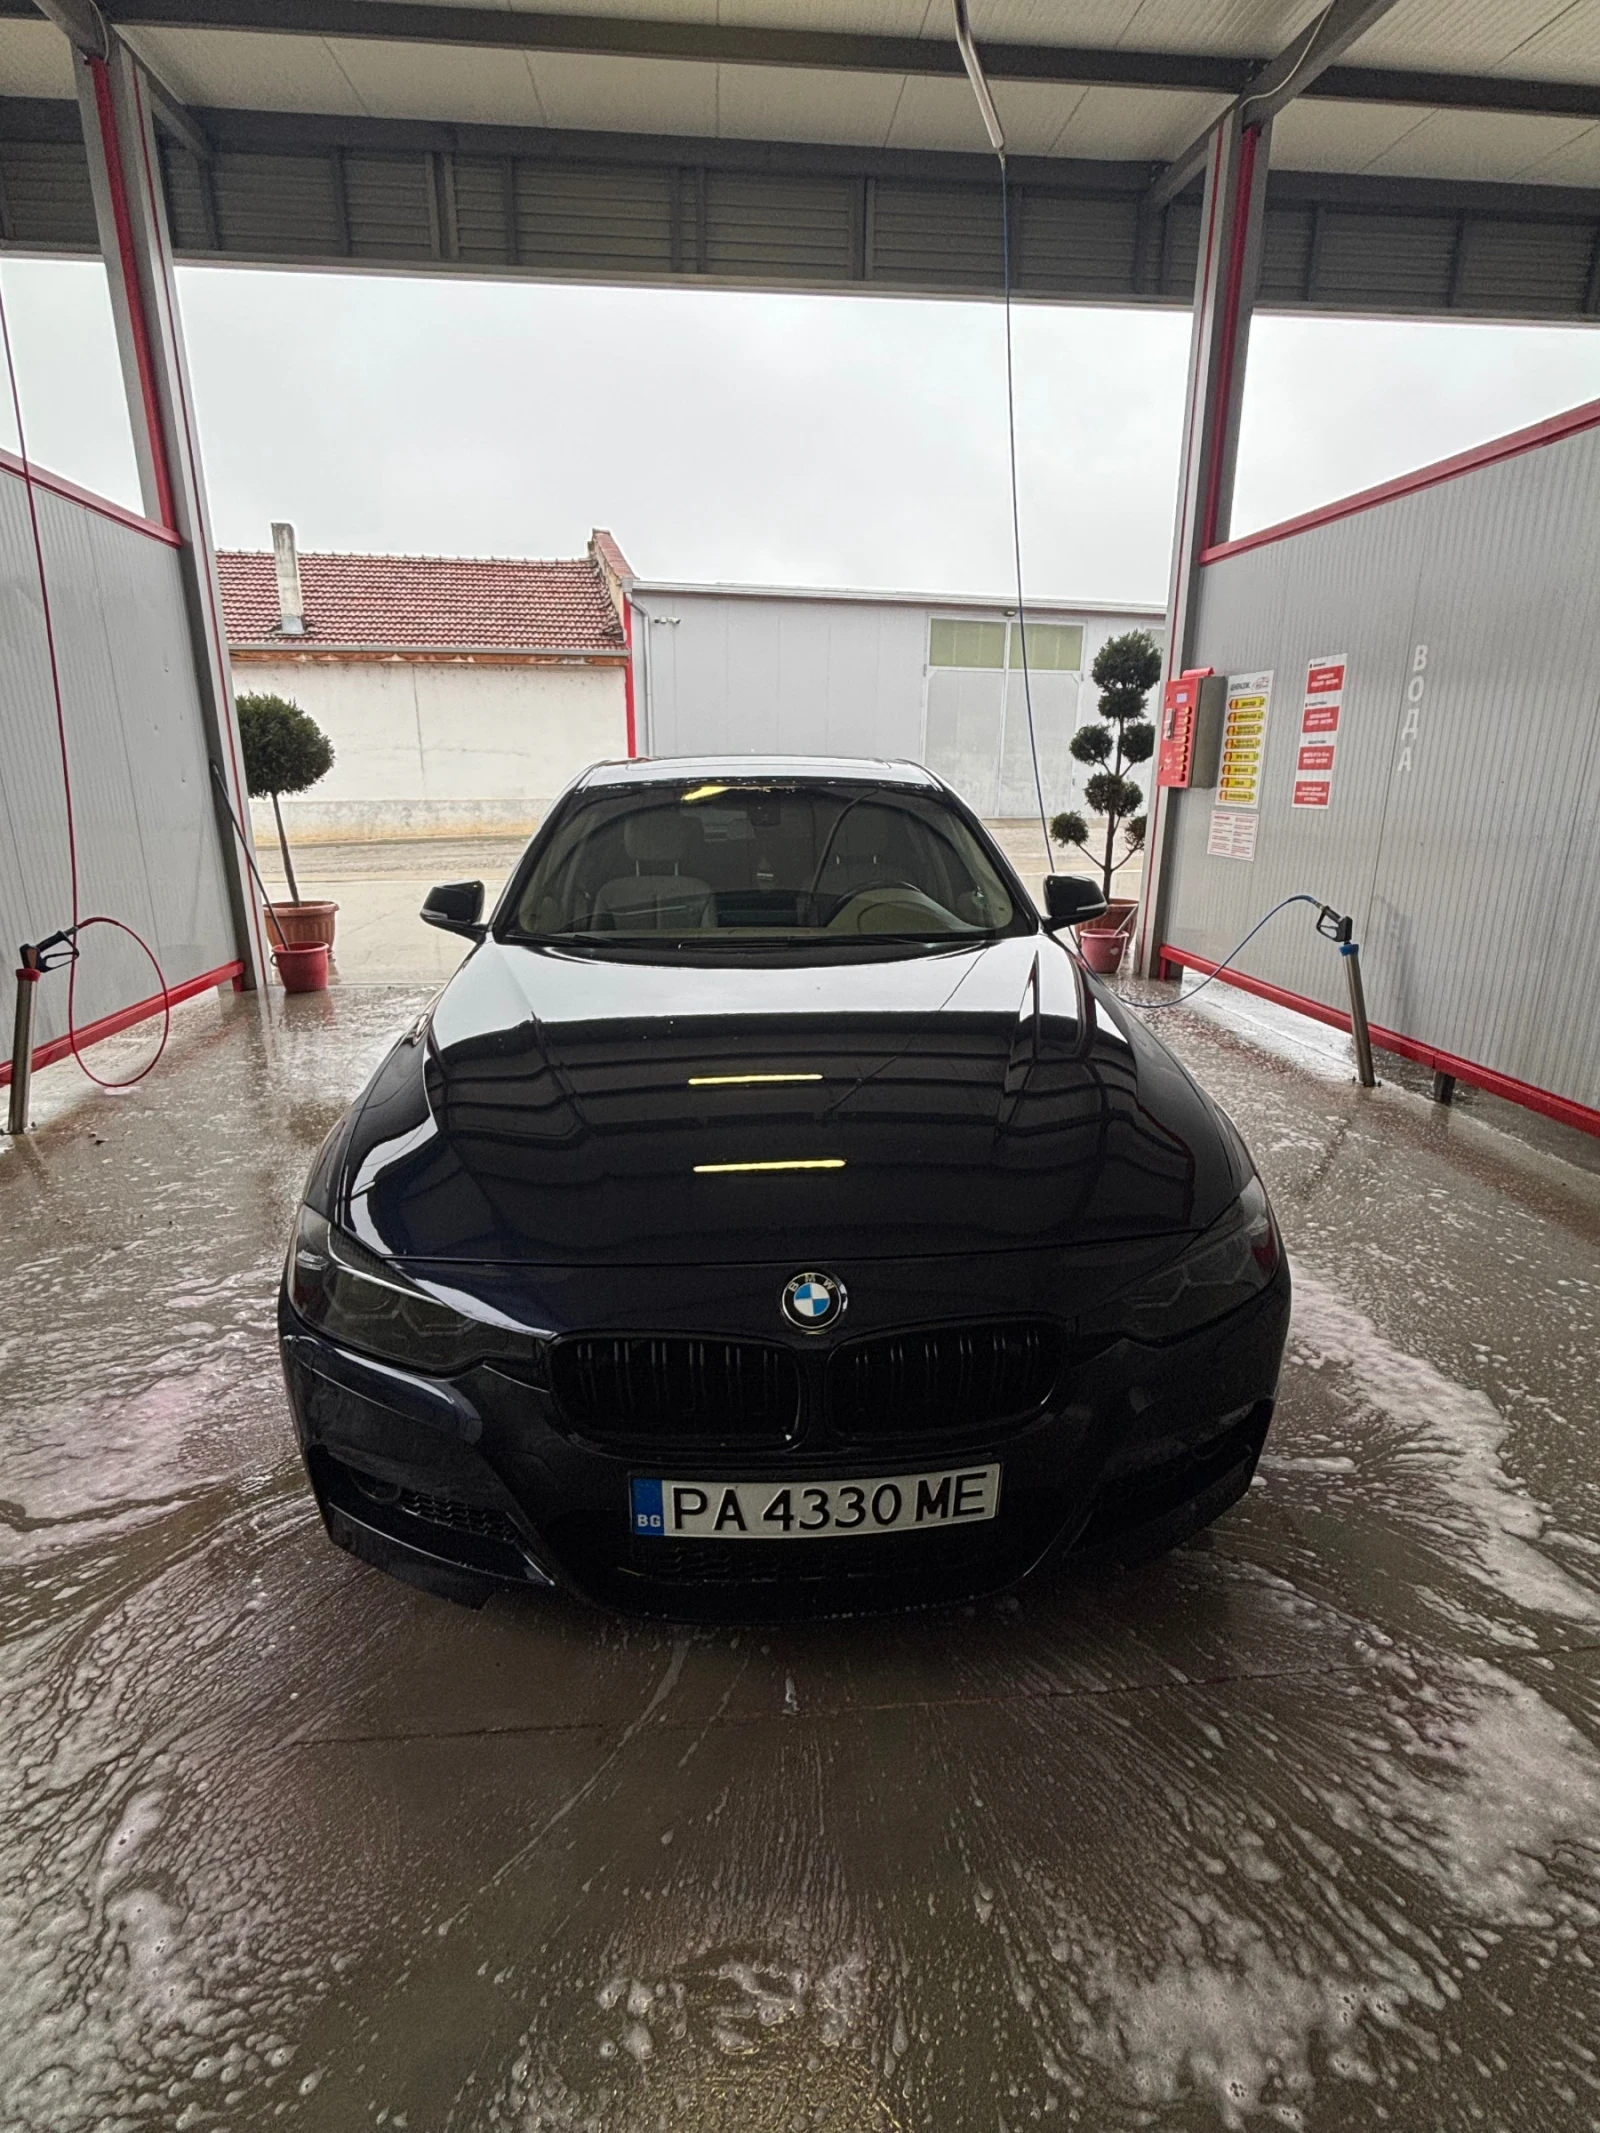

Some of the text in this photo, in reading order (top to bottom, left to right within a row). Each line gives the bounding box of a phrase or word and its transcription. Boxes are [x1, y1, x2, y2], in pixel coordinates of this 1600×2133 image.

[1397, 644, 1428, 772] ВОДА
[788, 1273, 836, 1292] BMW
[637, 1514, 661, 1527] BG
[672, 1471, 988, 1532] PA 4330 ME
